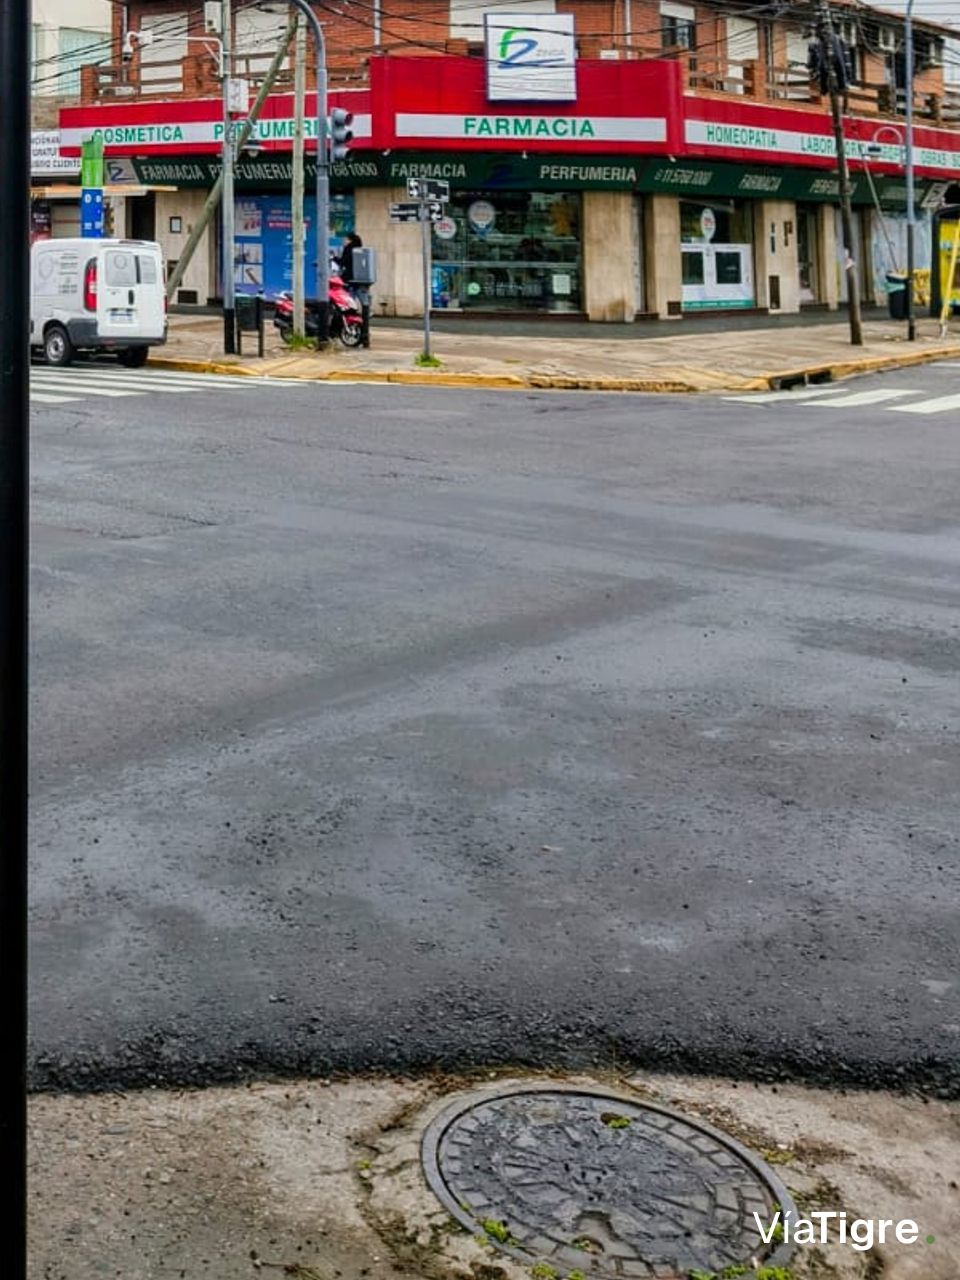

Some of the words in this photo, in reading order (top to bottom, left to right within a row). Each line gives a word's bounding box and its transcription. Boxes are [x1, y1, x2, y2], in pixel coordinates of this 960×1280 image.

[463, 117, 595, 138] FARMACIA
[707, 125, 778, 148] HOMEOPATIA
[140, 165, 205, 180] FARMACIA
[208, 164, 293, 180] PEFUMERIA
[391, 163, 467, 178] FARMACIA
[540, 165, 637, 182] PERFUMERIA
